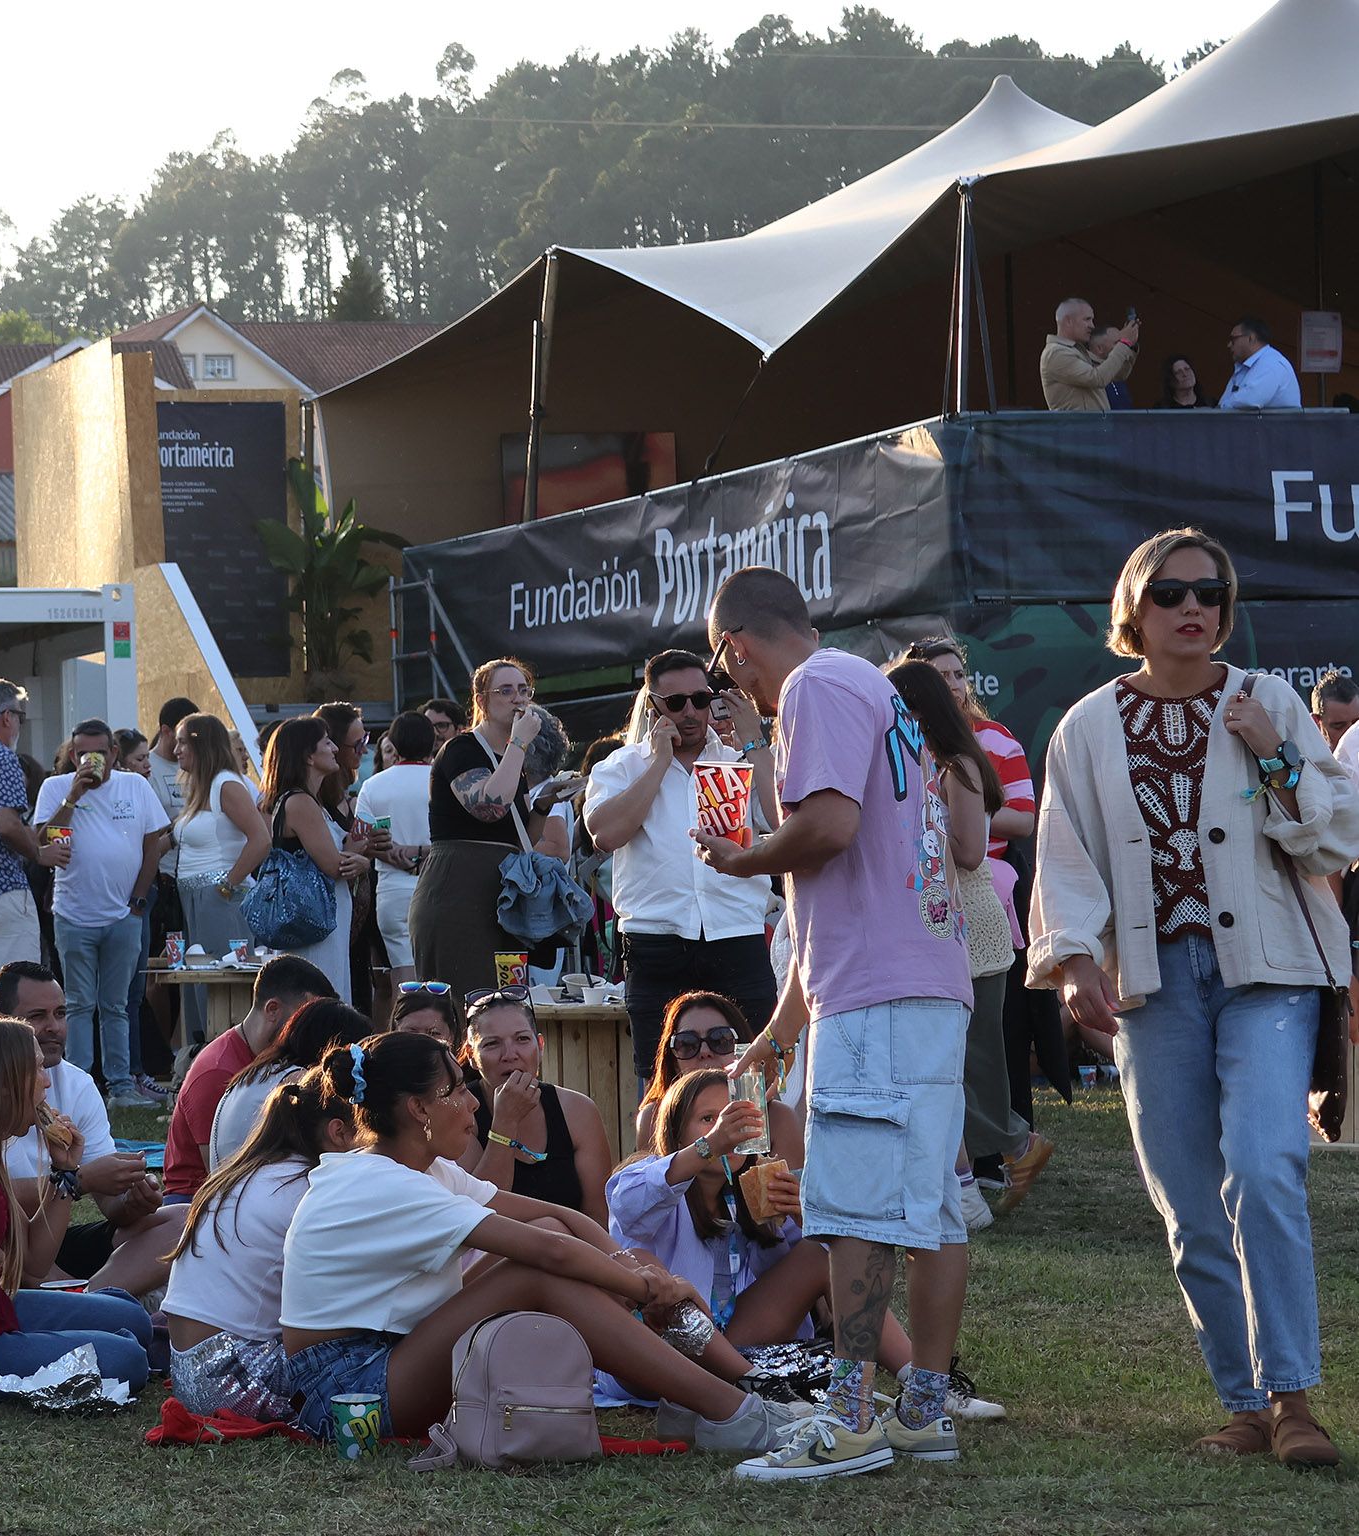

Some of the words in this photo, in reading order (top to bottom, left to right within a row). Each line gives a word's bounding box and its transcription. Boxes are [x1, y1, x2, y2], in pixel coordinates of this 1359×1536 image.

[158, 429, 201, 440] undación
[157, 441, 235, 468] ortamérica
[509, 556, 641, 631] Fundación
